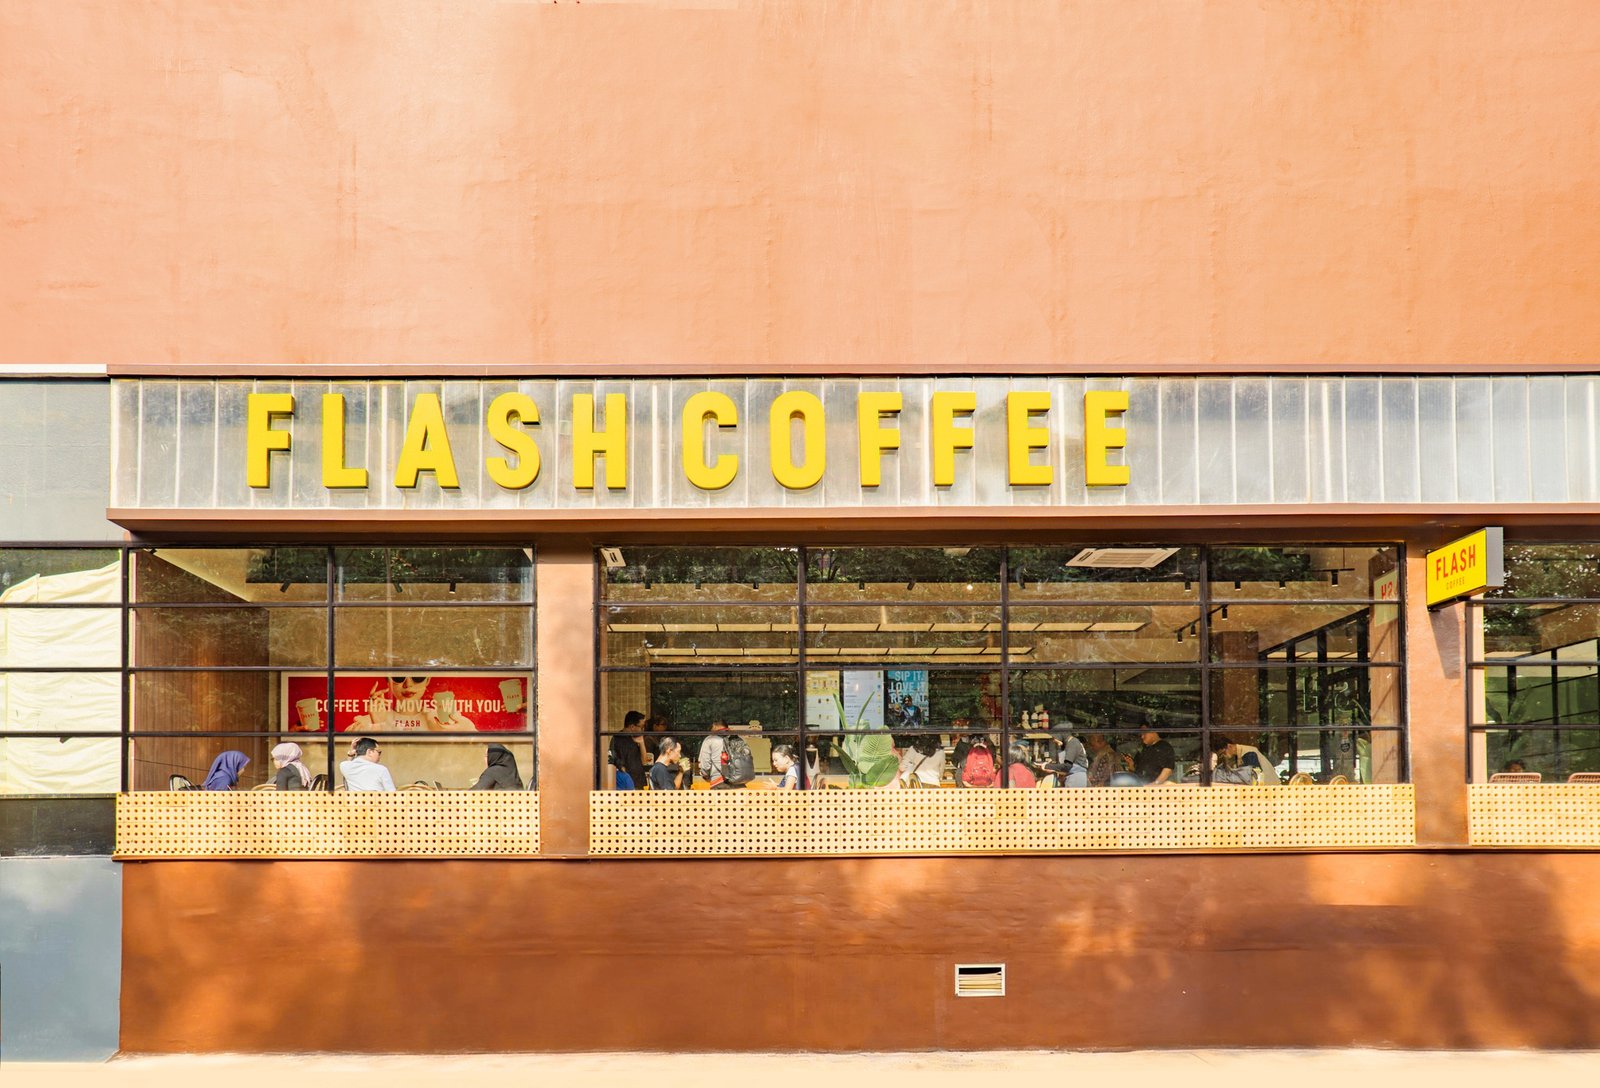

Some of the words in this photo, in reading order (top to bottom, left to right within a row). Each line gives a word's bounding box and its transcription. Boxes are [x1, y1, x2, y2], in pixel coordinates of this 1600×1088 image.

[247, 391, 627, 489] FLASH
[682, 390, 1131, 490] COFFEE
[1436, 544, 1476, 580] FLASH
[1446, 576, 1465, 590] COFFEE
[895, 670, 911, 681] SIP
[890, 682, 915, 693] LOVE
[362, 699, 393, 713] THAT
[396, 699, 438, 713] MOVES
[442, 699, 473, 713] WITH
[476, 699, 501, 713] YOU
